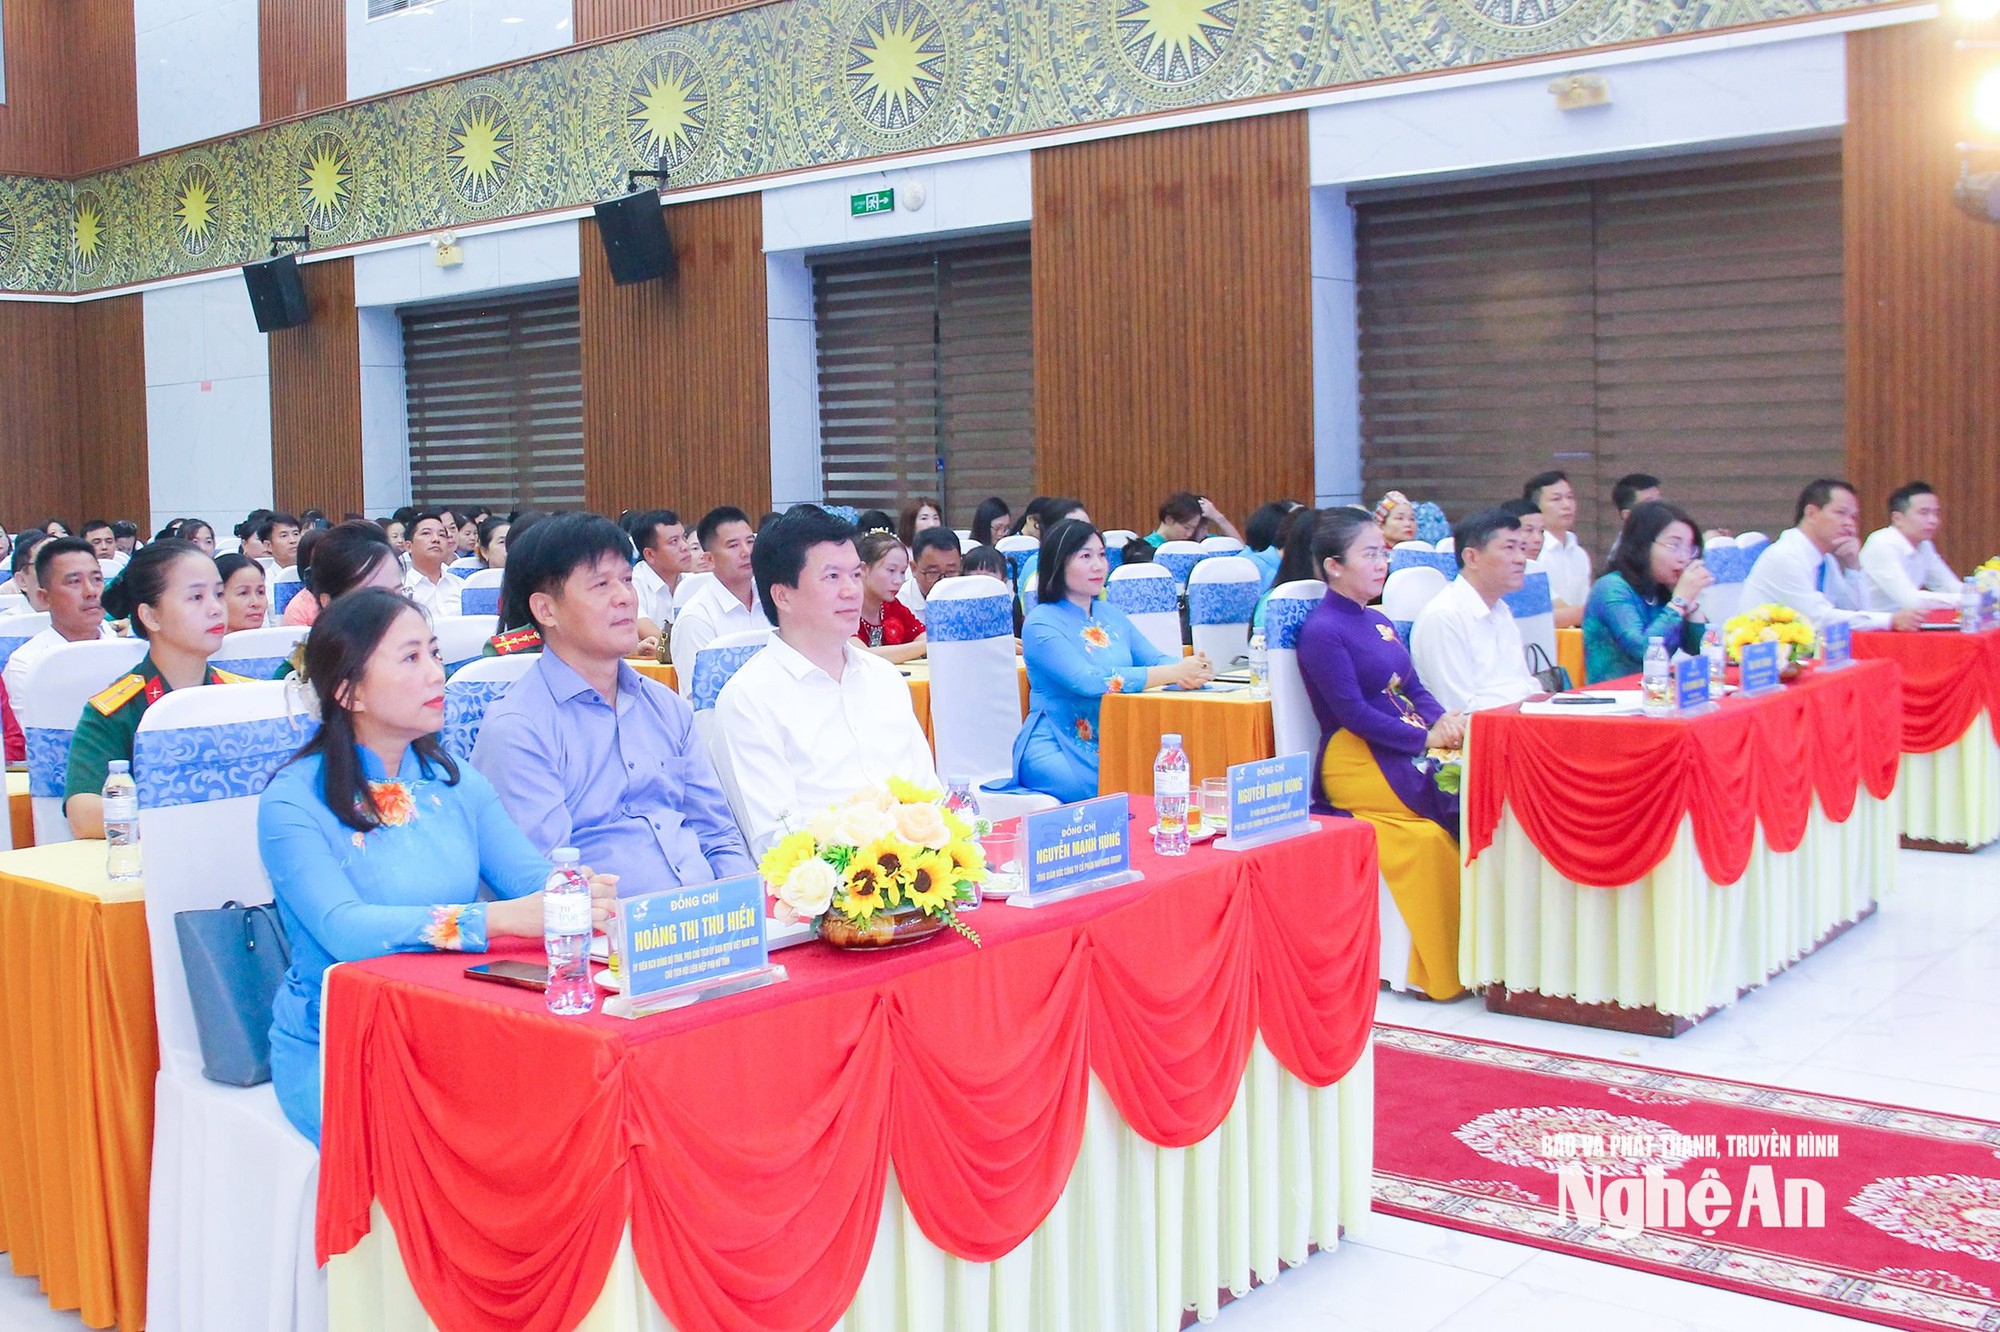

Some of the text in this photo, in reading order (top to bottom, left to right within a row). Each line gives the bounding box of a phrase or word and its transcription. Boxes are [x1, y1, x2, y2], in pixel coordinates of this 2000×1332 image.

[1062, 821, 1096, 837] ĐỒNG CHÍ
[1036, 831, 1120, 864] NGUYỄN MẠNH HÙNG
[670, 889, 719, 911] ĐỒNG CHÍ
[634, 903, 755, 952] HOÀNG THỊ THU HIỀN
